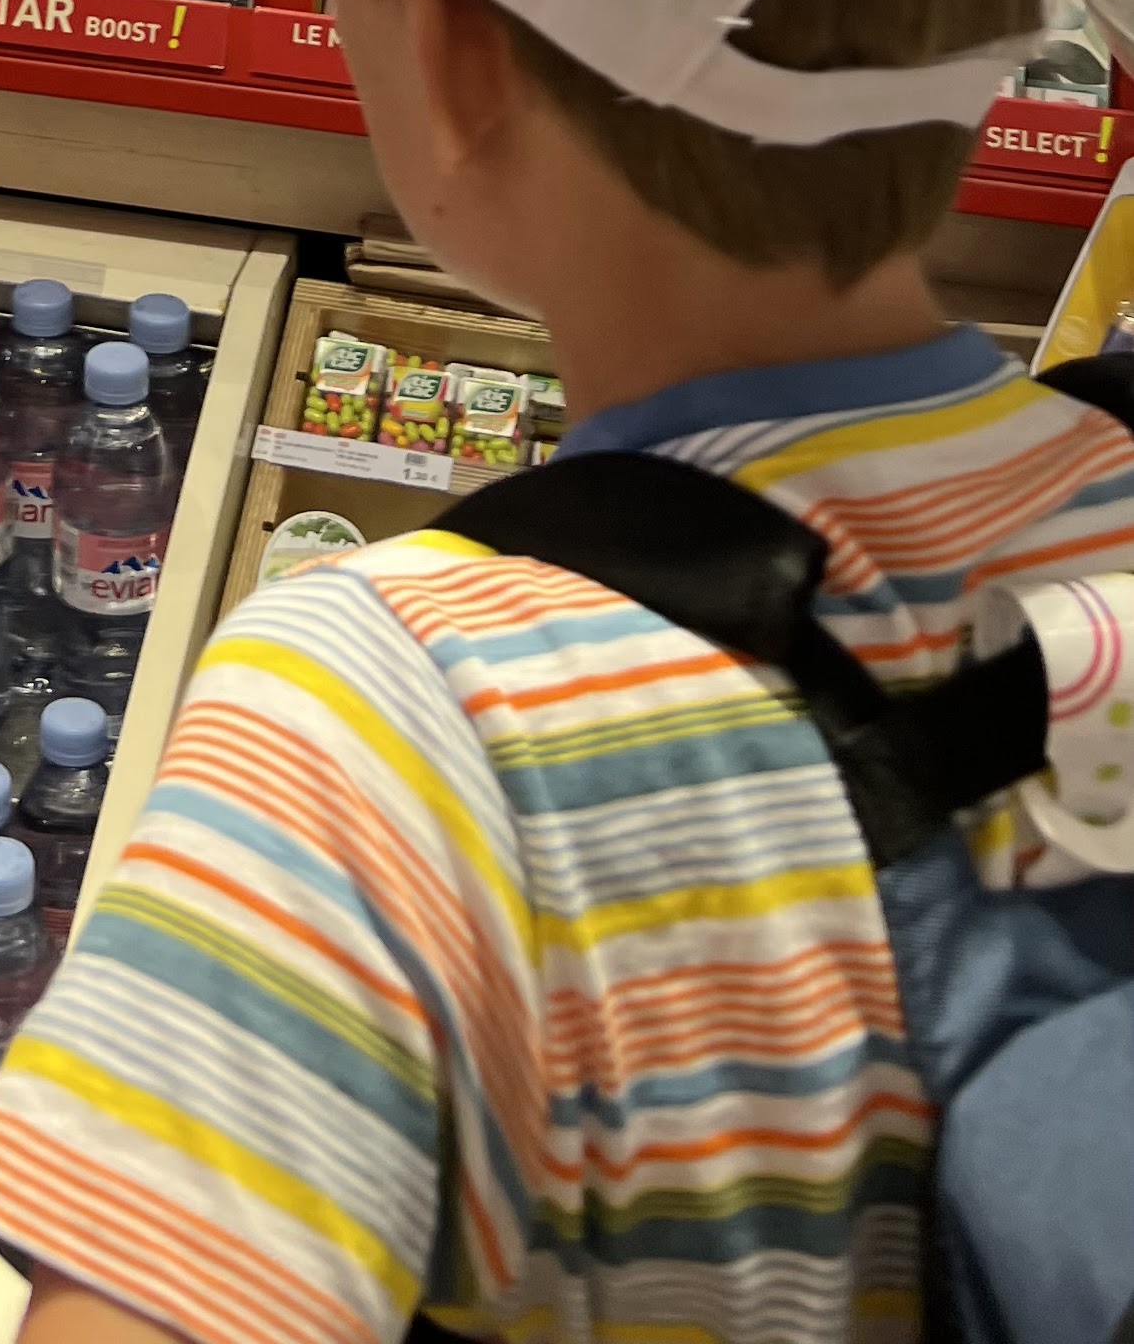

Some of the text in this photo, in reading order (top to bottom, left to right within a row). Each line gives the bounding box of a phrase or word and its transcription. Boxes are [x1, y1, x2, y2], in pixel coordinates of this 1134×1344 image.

[83, 15, 162, 46] BOOST
[291, 22, 324, 47] LE
[985, 126, 1089, 158] SELECT
[89, 574, 159, 600] evia
